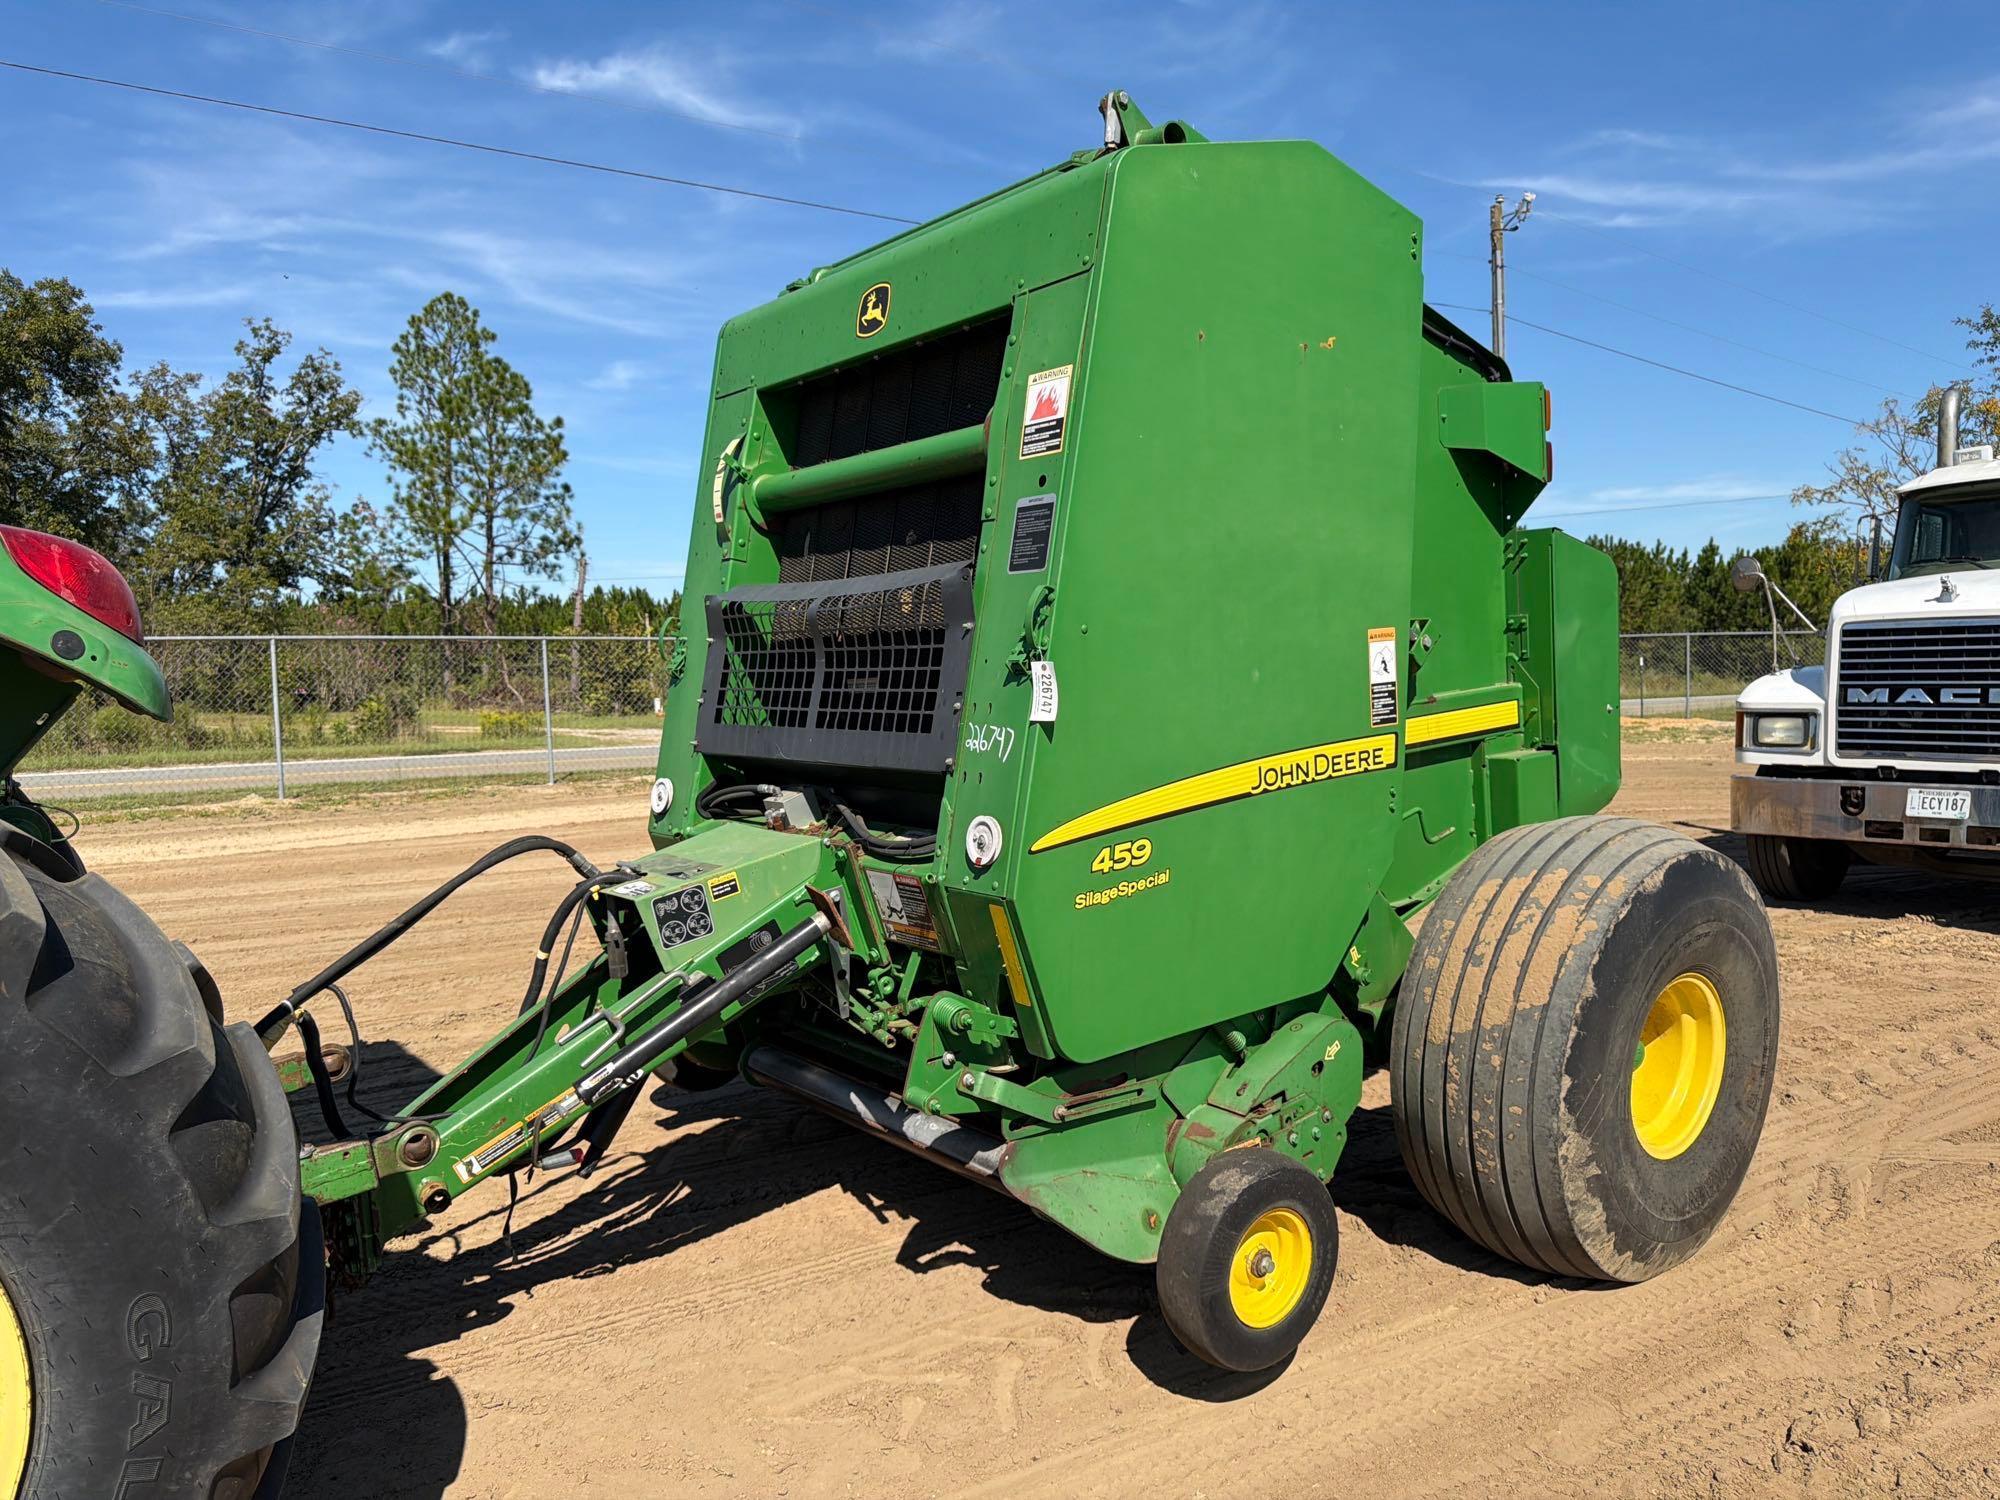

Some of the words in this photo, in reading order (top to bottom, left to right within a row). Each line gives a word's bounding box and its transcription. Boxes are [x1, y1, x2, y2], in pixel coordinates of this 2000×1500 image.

[1037, 367, 1069, 381] WARNING
[1040, 673, 1053, 714] 226747
[1846, 687, 2000, 704] MAC
[965, 722, 1015, 763] 226747
[1251, 760, 1309, 791] JOHN
[1313, 747, 1384, 777] DEERE
[1921, 796, 1967, 812] ECY187
[1091, 837, 1152, 874] 459
[1074, 868, 1171, 909] SilageSpecial
